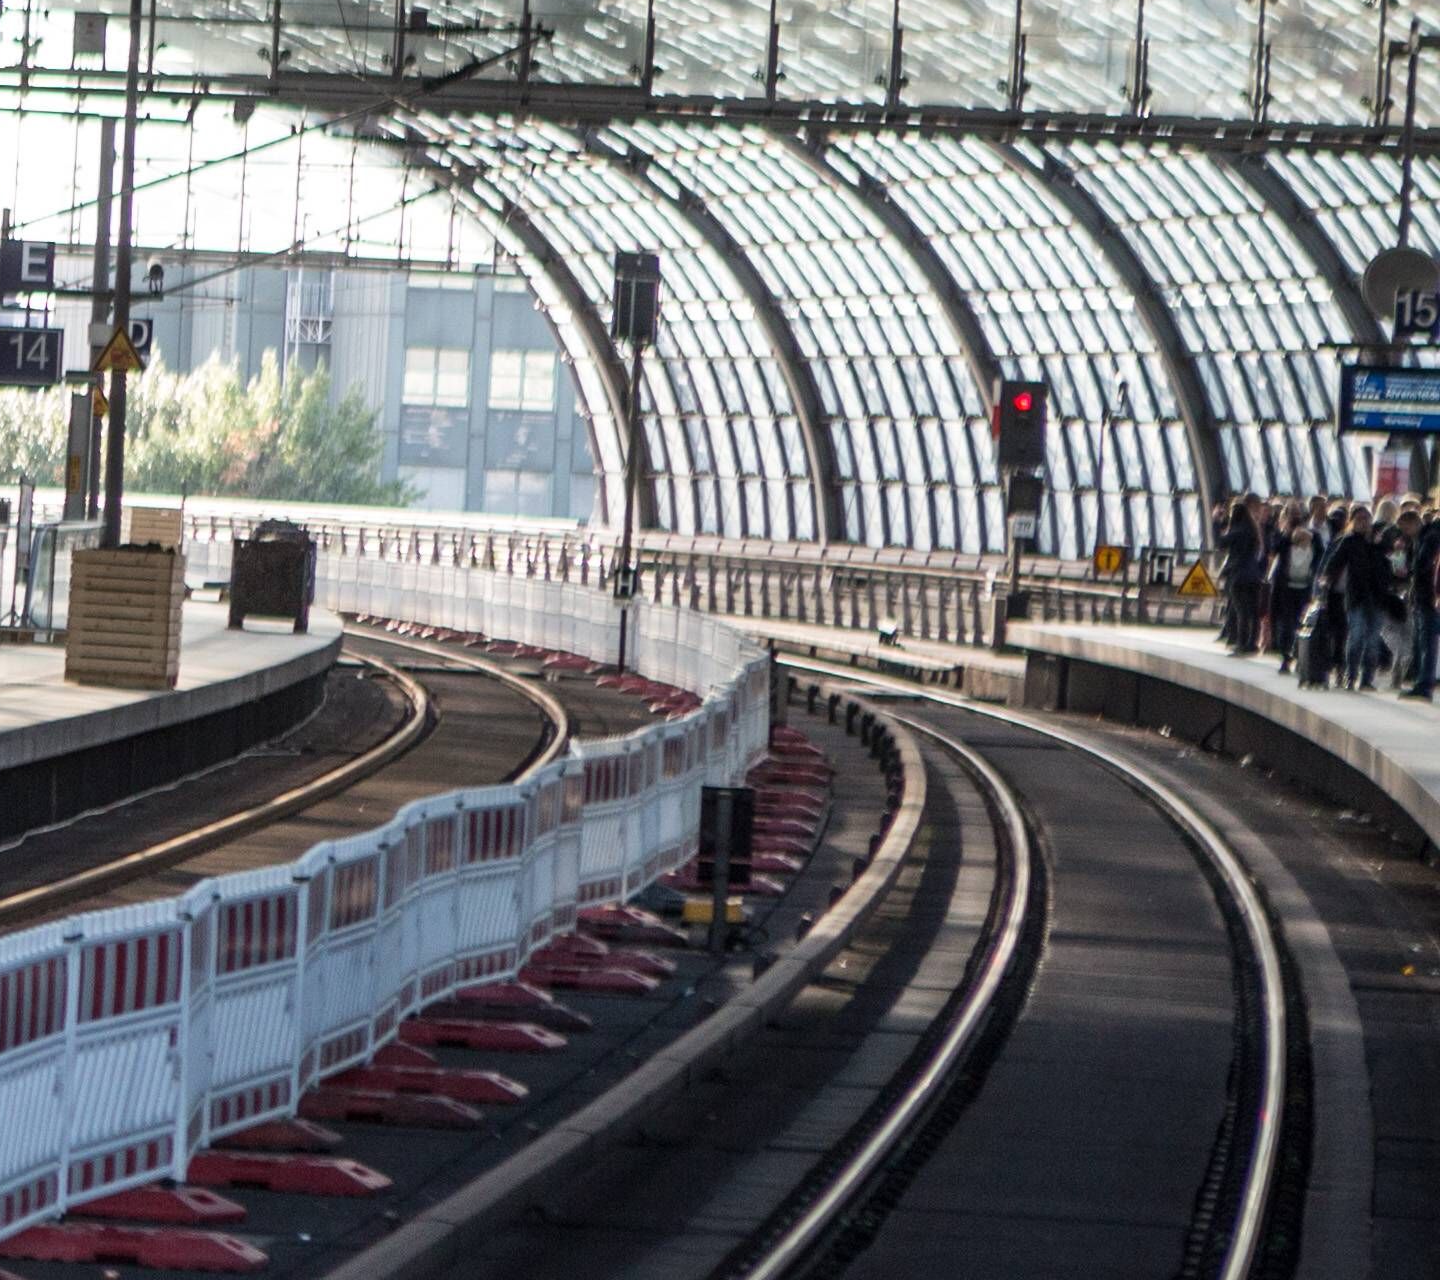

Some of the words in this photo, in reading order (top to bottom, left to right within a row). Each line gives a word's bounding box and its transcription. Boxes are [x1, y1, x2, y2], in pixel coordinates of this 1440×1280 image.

[21, 241, 50, 283] E
[1397, 292, 1439, 329] 15
[9, 332, 50, 371] 14
